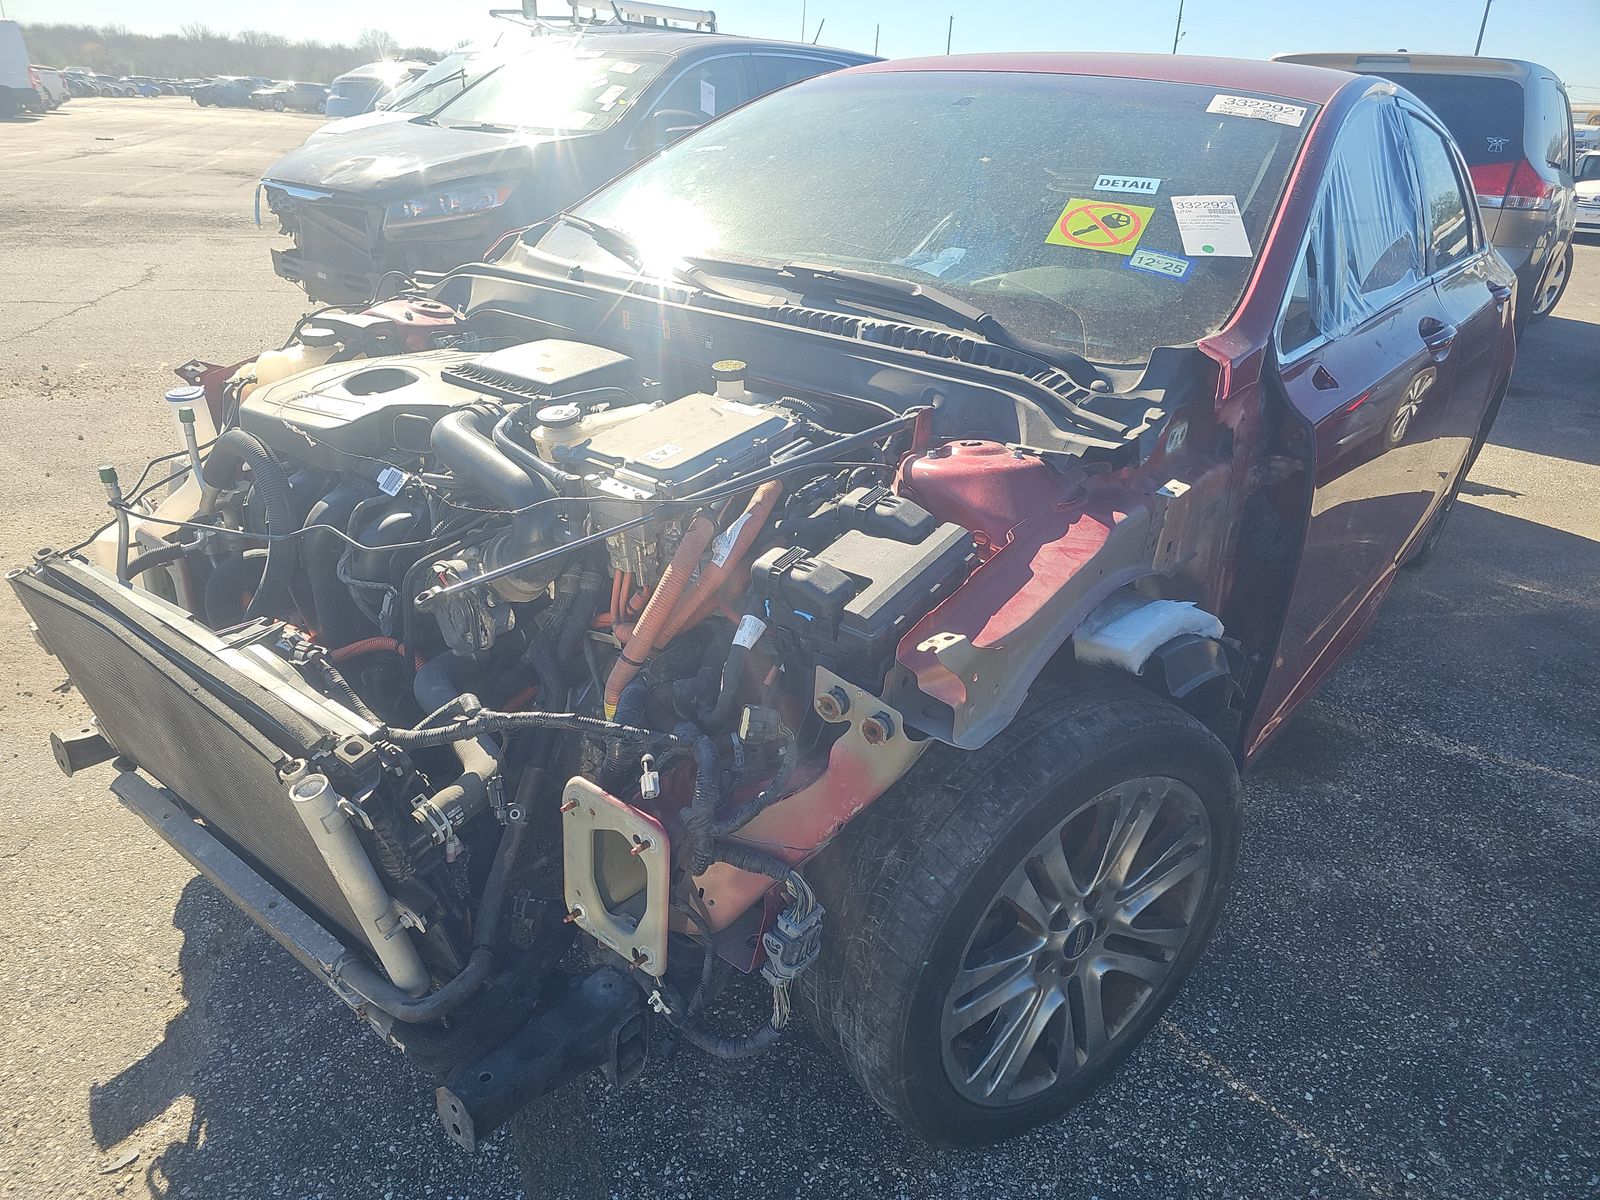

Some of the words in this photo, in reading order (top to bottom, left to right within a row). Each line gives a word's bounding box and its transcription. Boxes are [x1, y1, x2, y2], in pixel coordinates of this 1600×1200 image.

[1224, 97, 1305, 117] 3322921
[1098, 178, 1154, 190] DETAIL
[1176, 201, 1235, 210] 3322921
[1137, 256, 1156, 267] 12
[1162, 262, 1184, 274] 25
